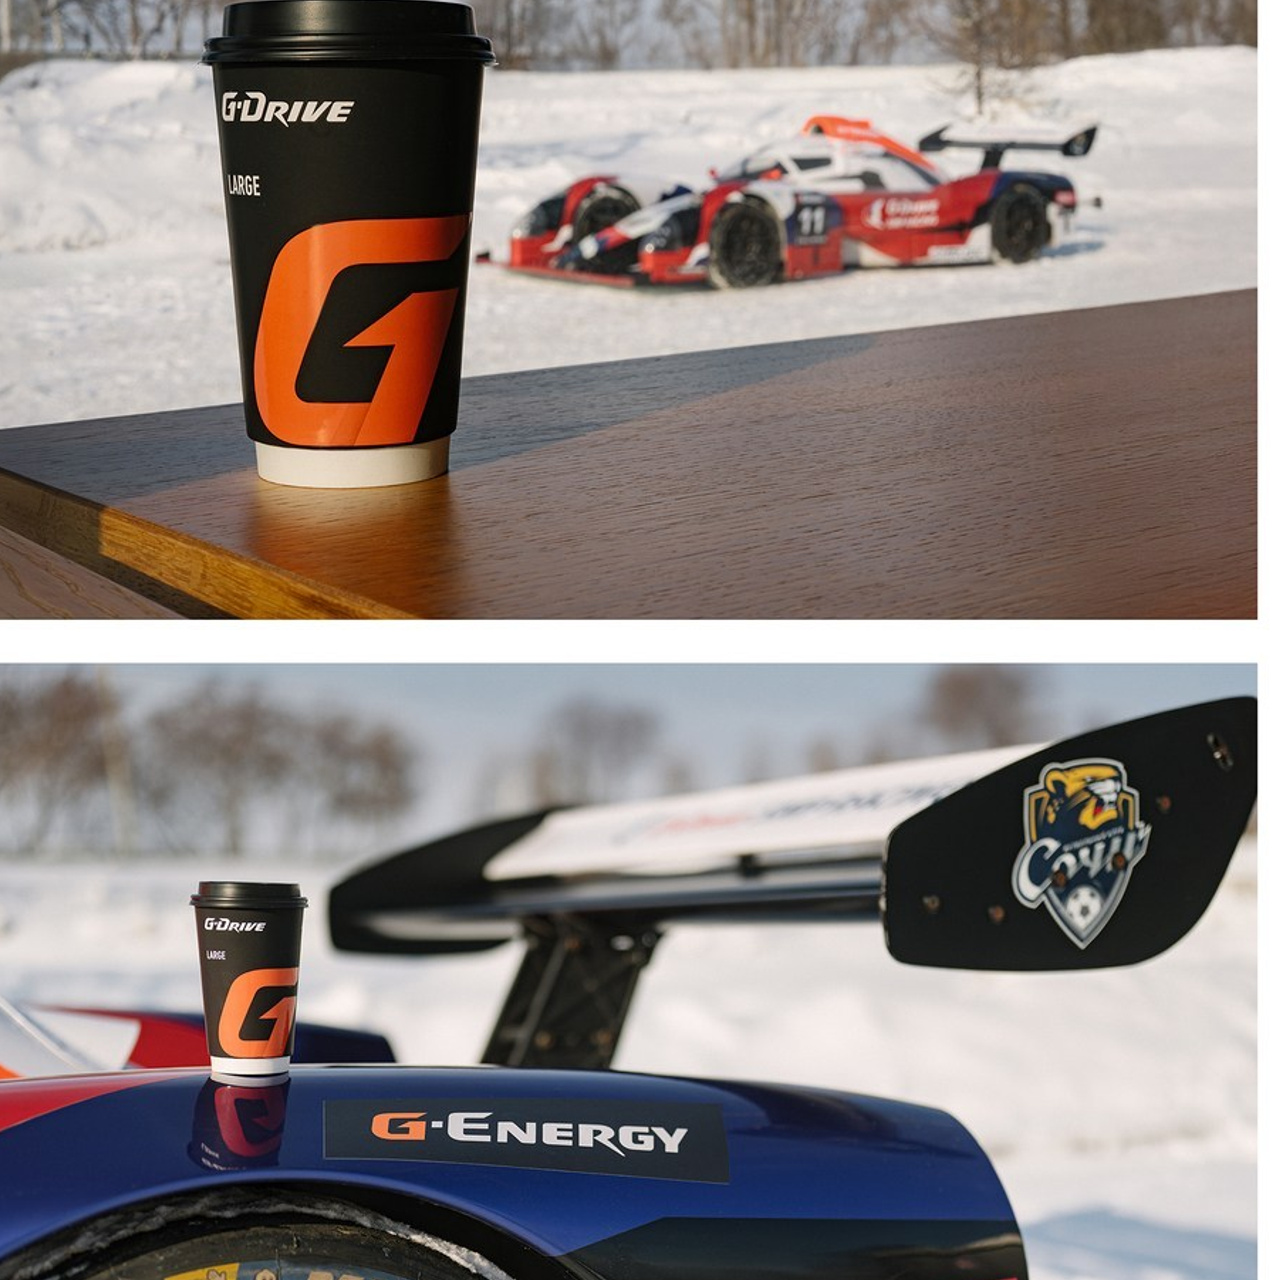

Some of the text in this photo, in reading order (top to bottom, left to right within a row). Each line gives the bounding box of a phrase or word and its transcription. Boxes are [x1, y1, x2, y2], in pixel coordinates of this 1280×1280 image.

[222, 91, 355, 128] G-DRIVE
[227, 173, 261, 197] LARGE
[204, 918, 267, 933] G-DRIVE
[206, 950, 226, 961] LARGE
[370, 1111, 689, 1157] G-ENERGY
